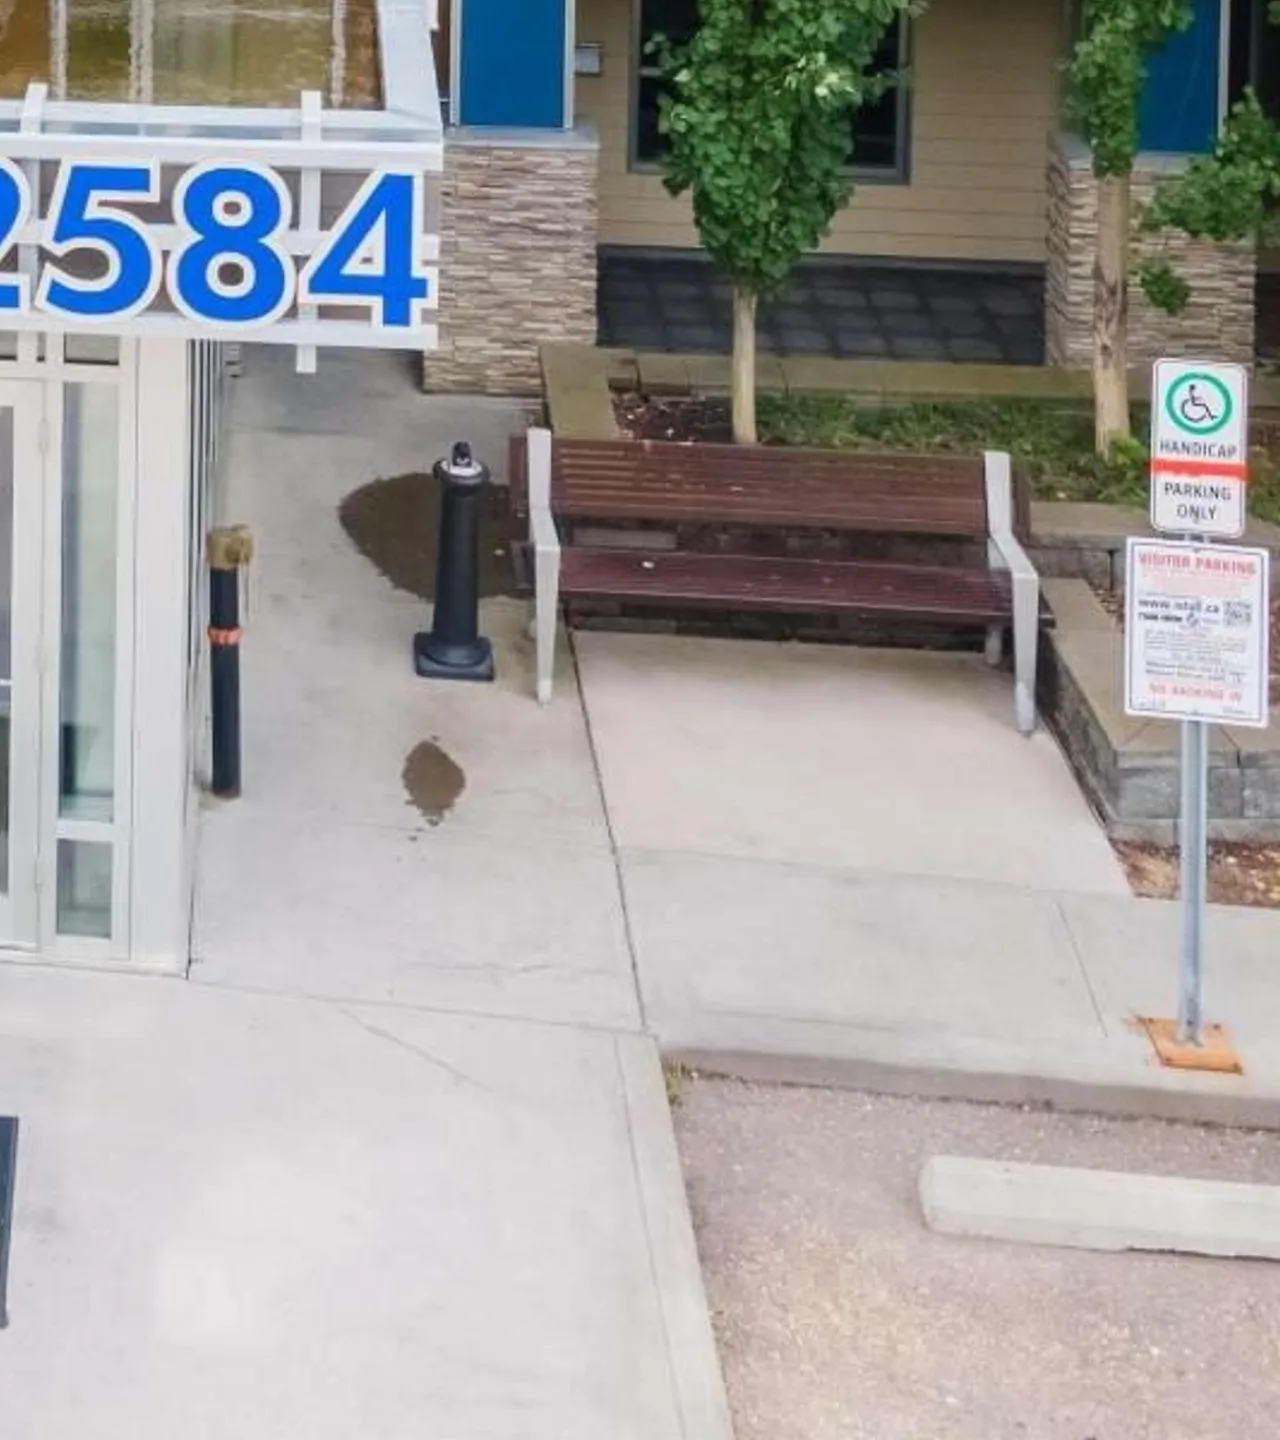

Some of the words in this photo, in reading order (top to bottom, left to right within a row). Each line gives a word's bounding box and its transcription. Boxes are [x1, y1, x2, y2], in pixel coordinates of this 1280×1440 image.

[1159, 440, 1237, 458] HANDICAP
[1164, 482, 1232, 500] PARKING
[1176, 503, 1216, 520] ONLY
